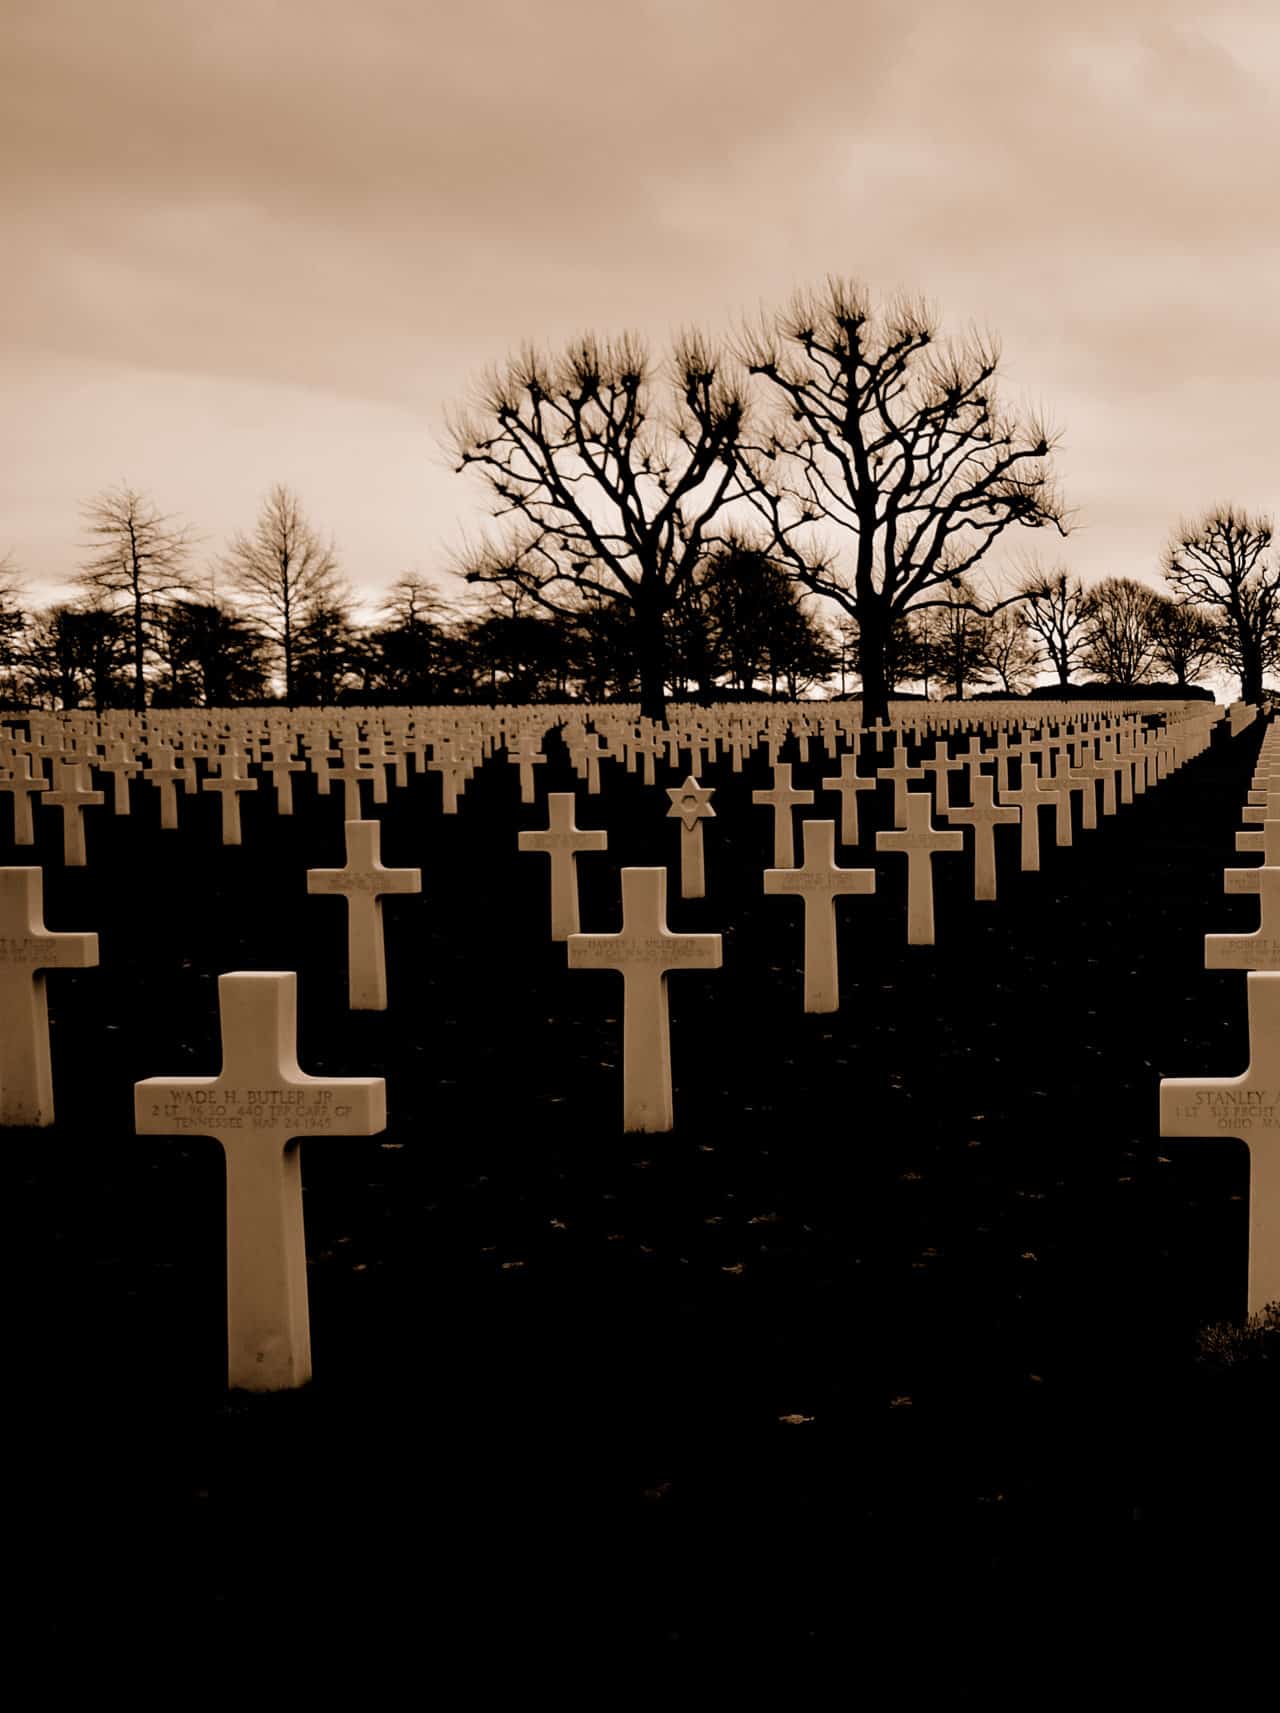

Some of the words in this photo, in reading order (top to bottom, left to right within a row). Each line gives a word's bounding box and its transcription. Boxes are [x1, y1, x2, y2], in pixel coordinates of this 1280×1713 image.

[170, 1090, 217, 1105] WADE
[223, 1090, 241, 1105] H.
[248, 1090, 304, 1105] BUTLER
[313, 1090, 333, 1105] JR
[1194, 1090, 1265, 1105] STANLEY
[151, 1105, 160, 1116] 2
[172, 1117, 243, 1129] TENNESSEE
[1217, 1118, 1253, 1129] OHIO
